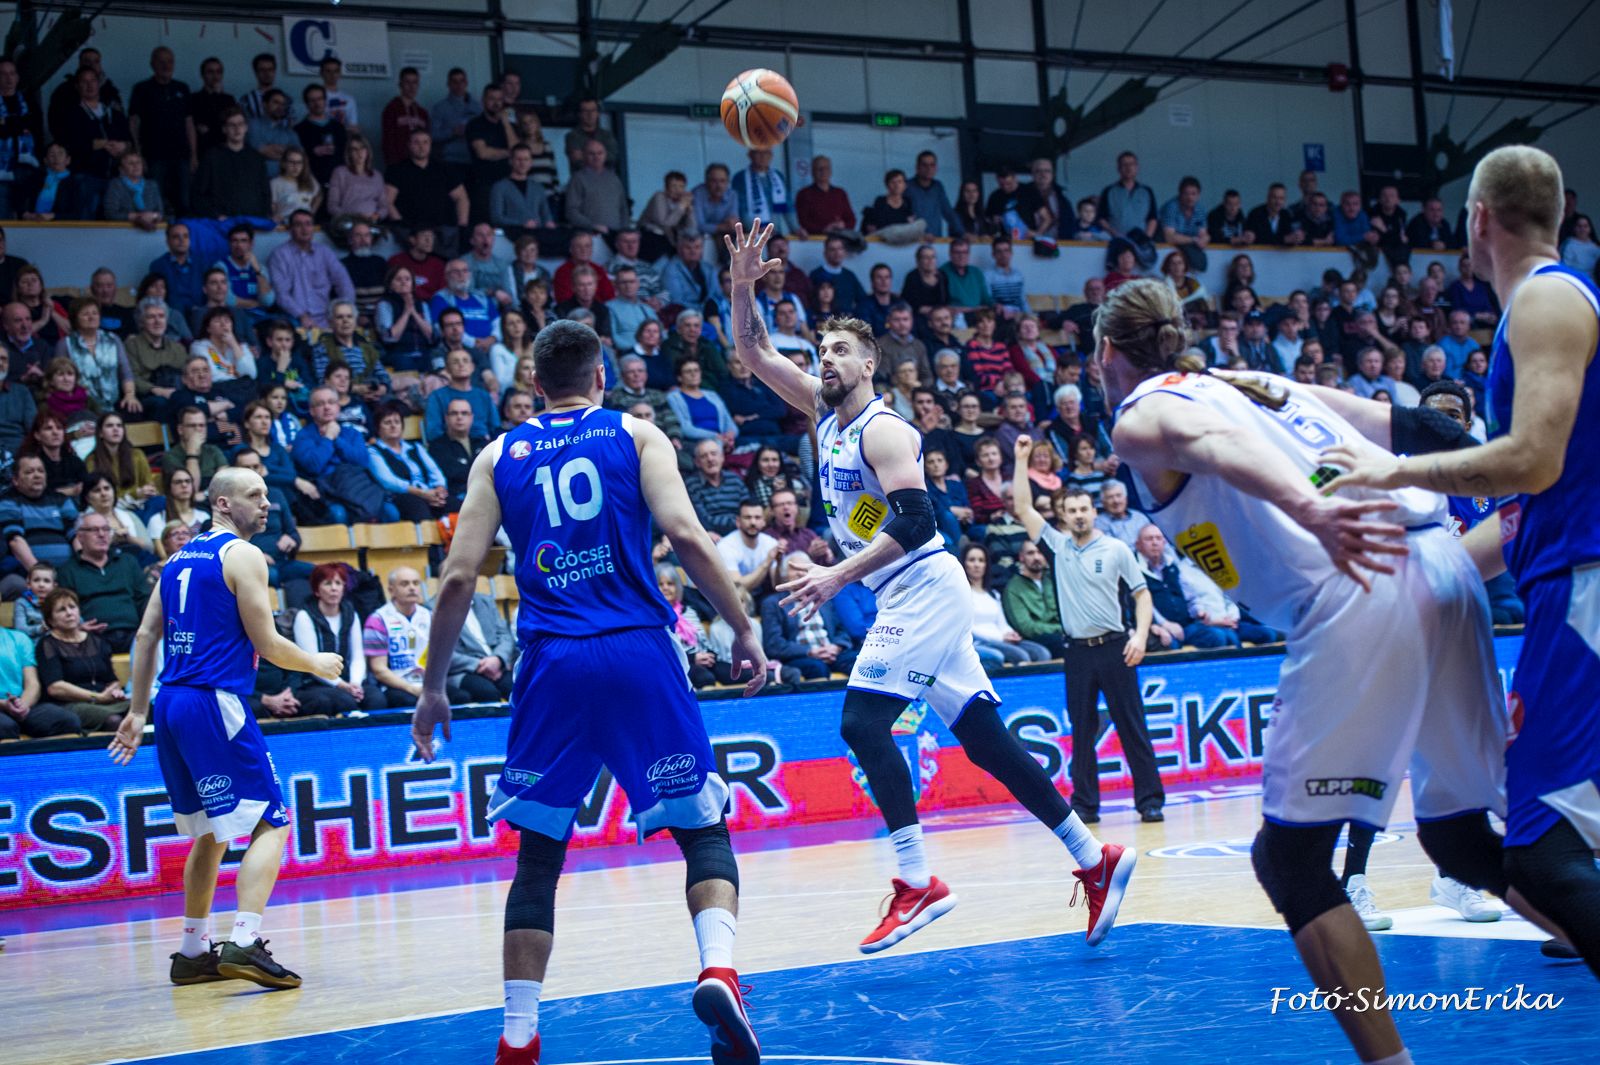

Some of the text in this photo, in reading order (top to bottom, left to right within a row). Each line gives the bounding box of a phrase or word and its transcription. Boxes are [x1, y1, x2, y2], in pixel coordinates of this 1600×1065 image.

[290, 19, 333, 67] C
[535, 427, 616, 451] Zalakerámia
[534, 456, 603, 528] 10
[554, 544, 611, 570] GÖCSEJ
[546, 559, 615, 589] nyomda
[176, 567, 193, 614] 1
[868, 624, 904, 637] ence
